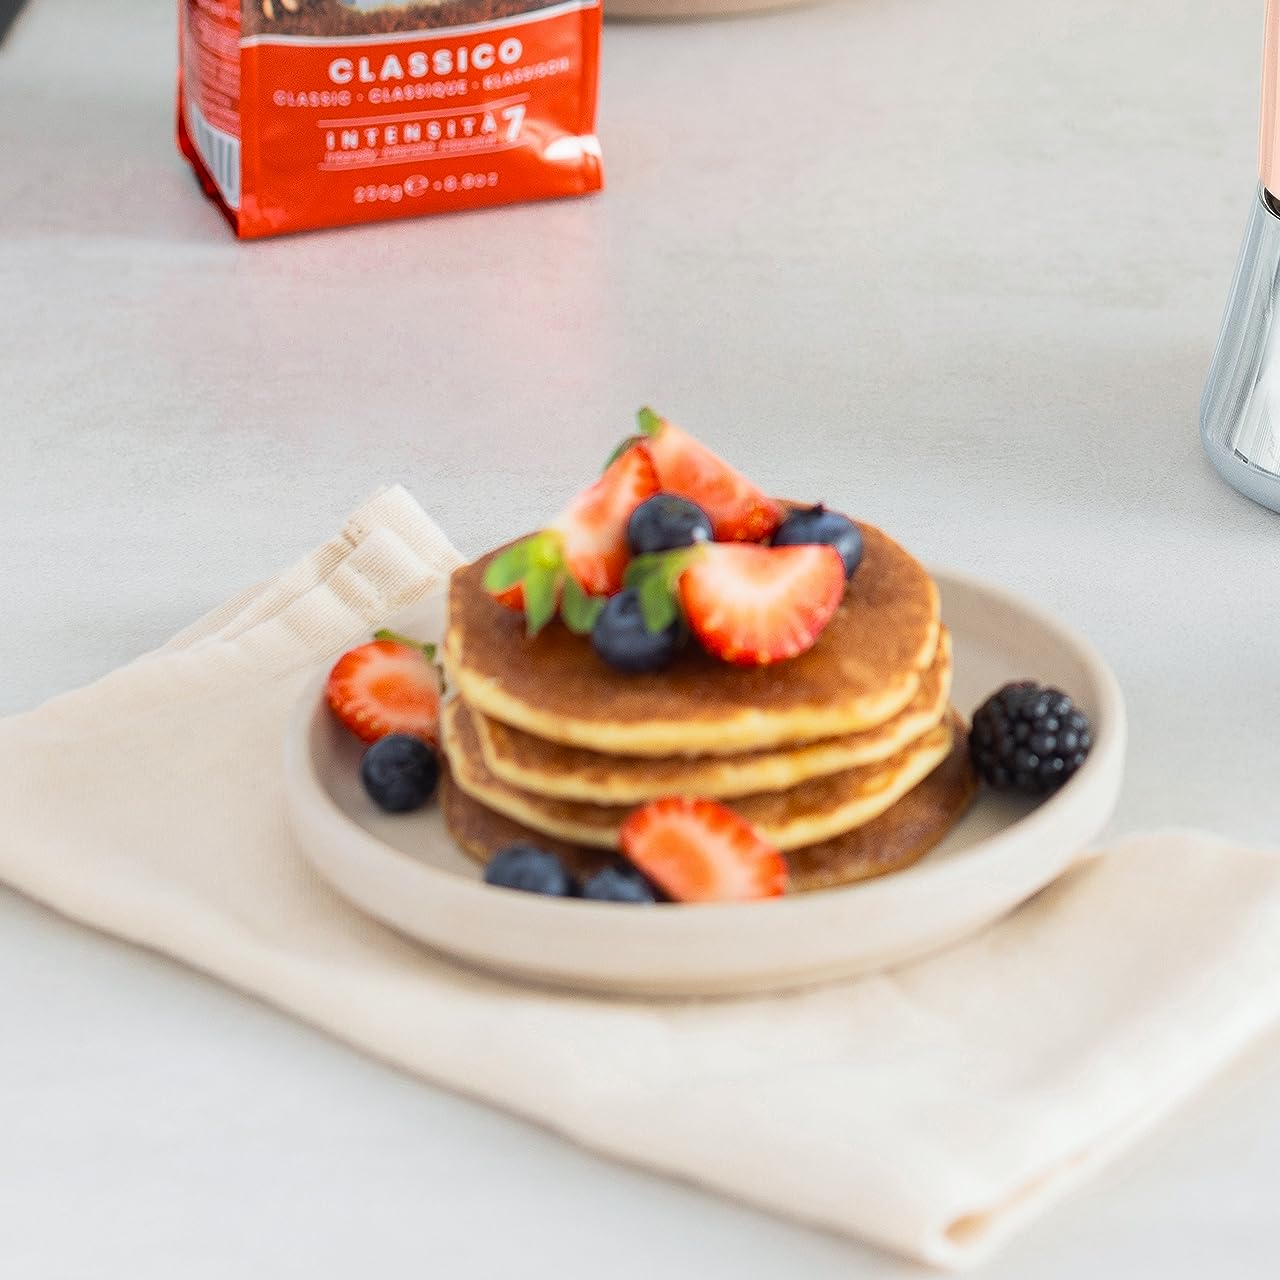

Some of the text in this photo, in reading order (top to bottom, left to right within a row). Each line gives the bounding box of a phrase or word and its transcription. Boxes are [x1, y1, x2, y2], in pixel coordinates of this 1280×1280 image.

[328, 37, 523, 84] CLASSICO
[272, 89, 352, 107] CLASSIC
[367, 78, 468, 104] CLASSIQUE
[502, 103, 527, 142] 7
